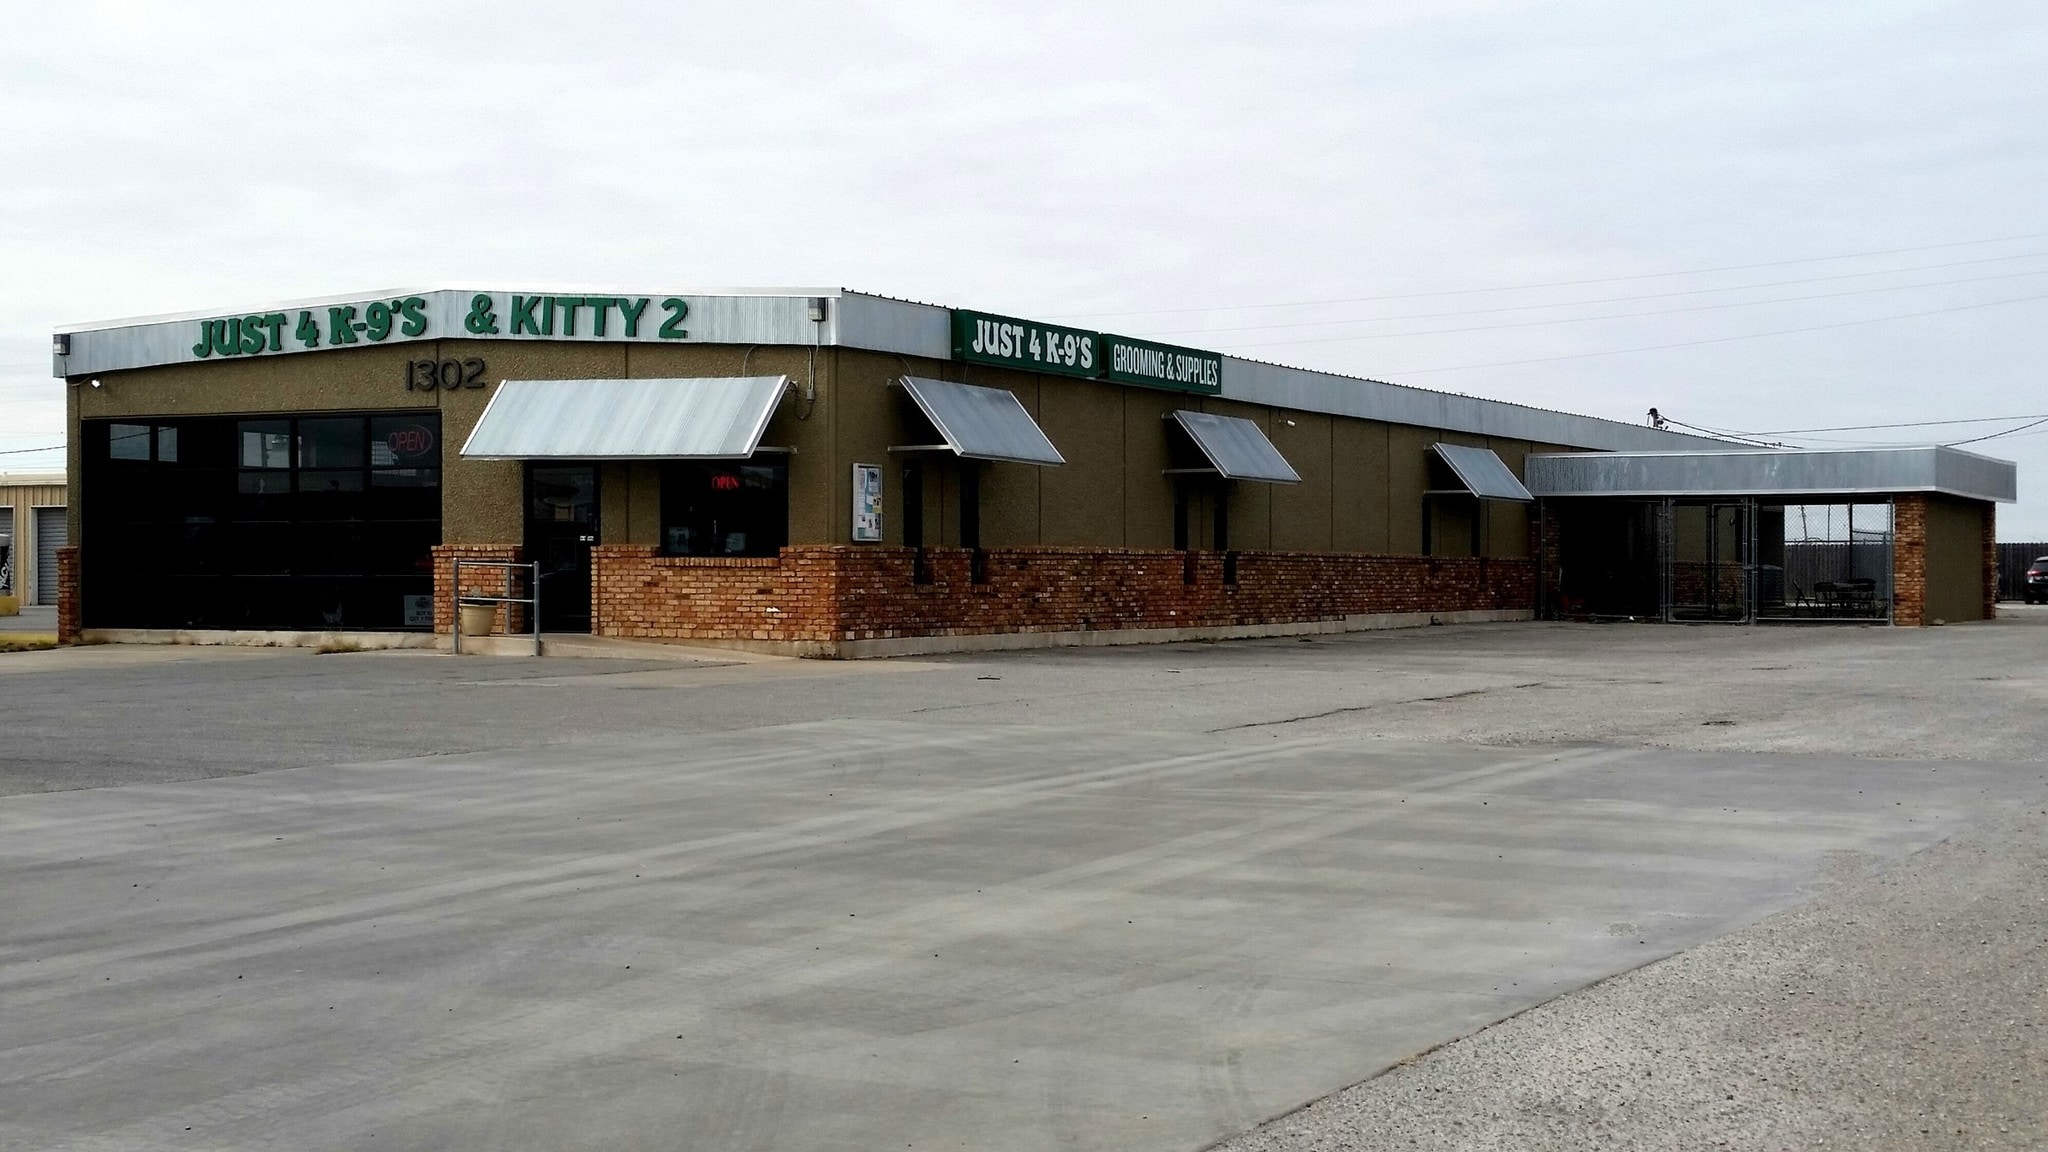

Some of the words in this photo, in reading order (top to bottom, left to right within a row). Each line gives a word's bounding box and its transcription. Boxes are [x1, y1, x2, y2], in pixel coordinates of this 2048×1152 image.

[193, 313, 286, 358] JUST
[296, 311, 319, 347] 4
[328, 297, 426, 344] K-9'S
[464, 294, 498, 334] &
[510, 295, 650, 338] KITTY
[659, 298, 688, 338] 2
[972, 319, 1024, 358] JUST
[1029, 329, 1041, 361] 4
[1046, 331, 1093, 369] K-9'S
[408, 358, 485, 391] 1302
[1113, 344, 1165, 379] GROOMING
[1166, 352, 1175, 380] &
[1176, 354, 1218, 386] SUPPLIES
[389, 431, 424, 451] OPEN
[711, 476, 738, 490] OPEN
